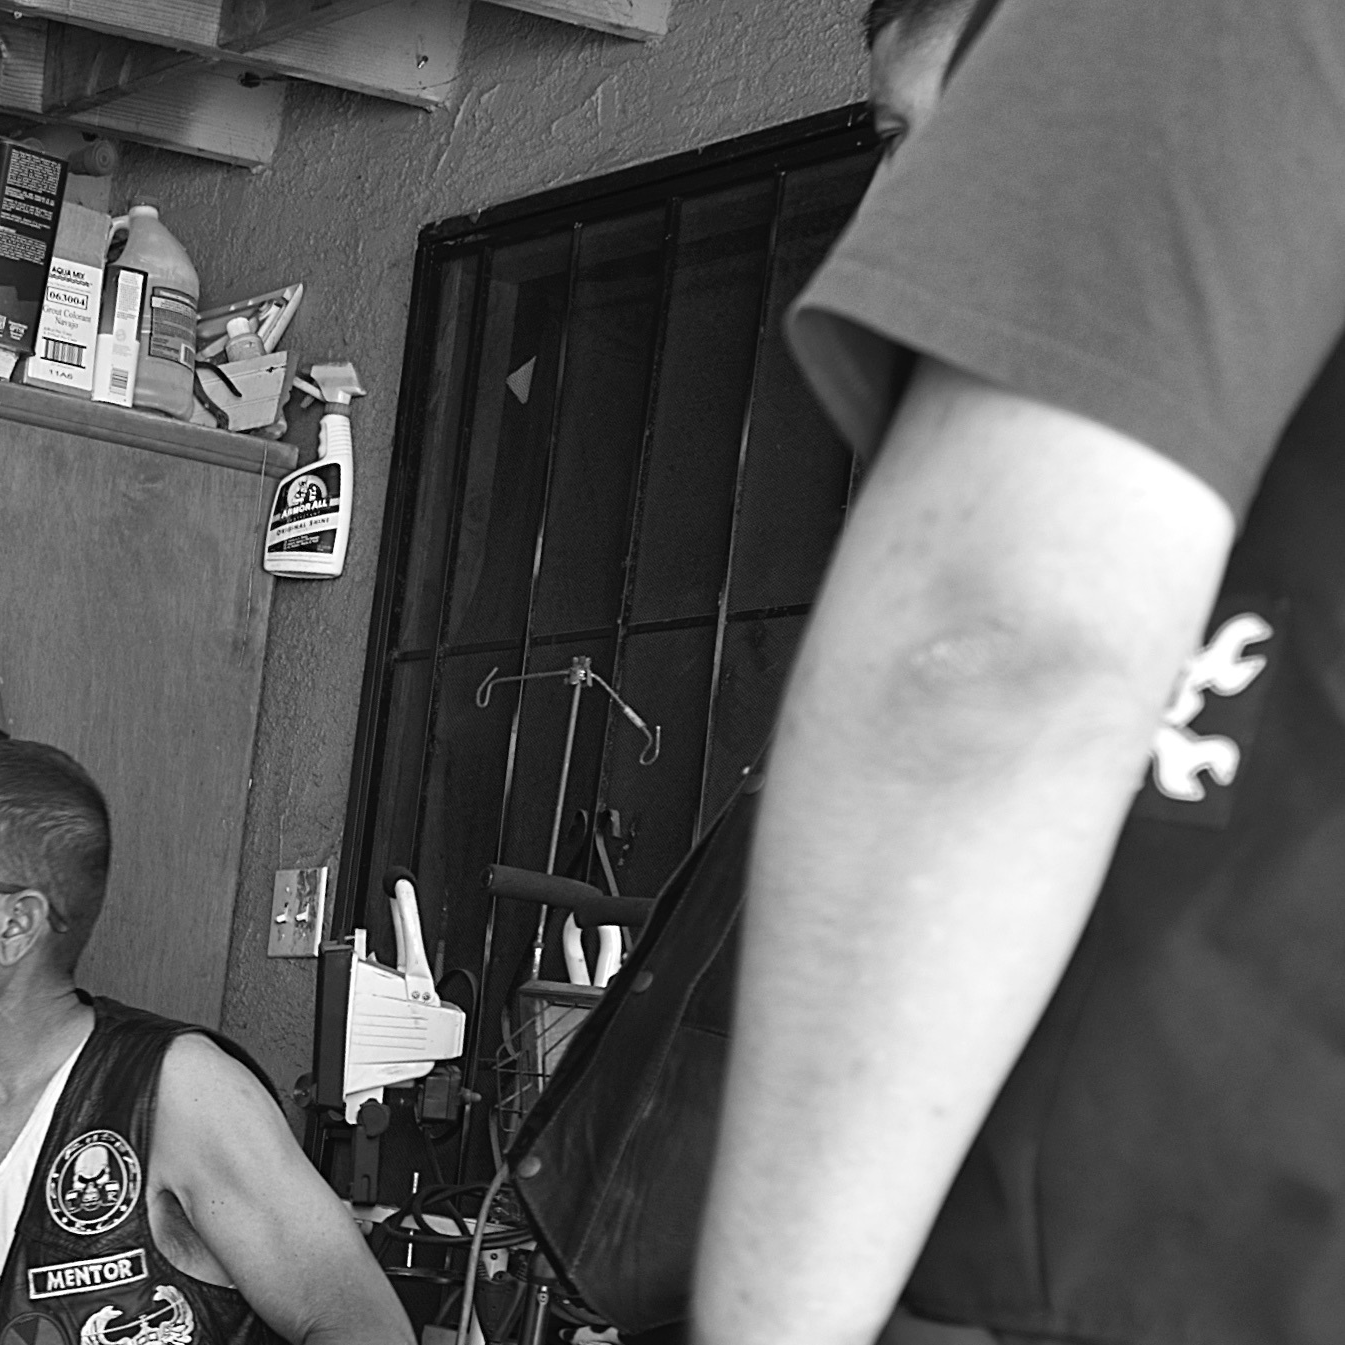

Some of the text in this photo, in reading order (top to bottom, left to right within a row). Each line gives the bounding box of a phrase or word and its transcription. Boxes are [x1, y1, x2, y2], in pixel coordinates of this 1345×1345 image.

[51, 266, 86, 280] AQUA MIX
[49, 290, 86, 307] 063004
[311, 499, 328, 510] ALL
[47, 1259, 133, 1291] MENTOR
